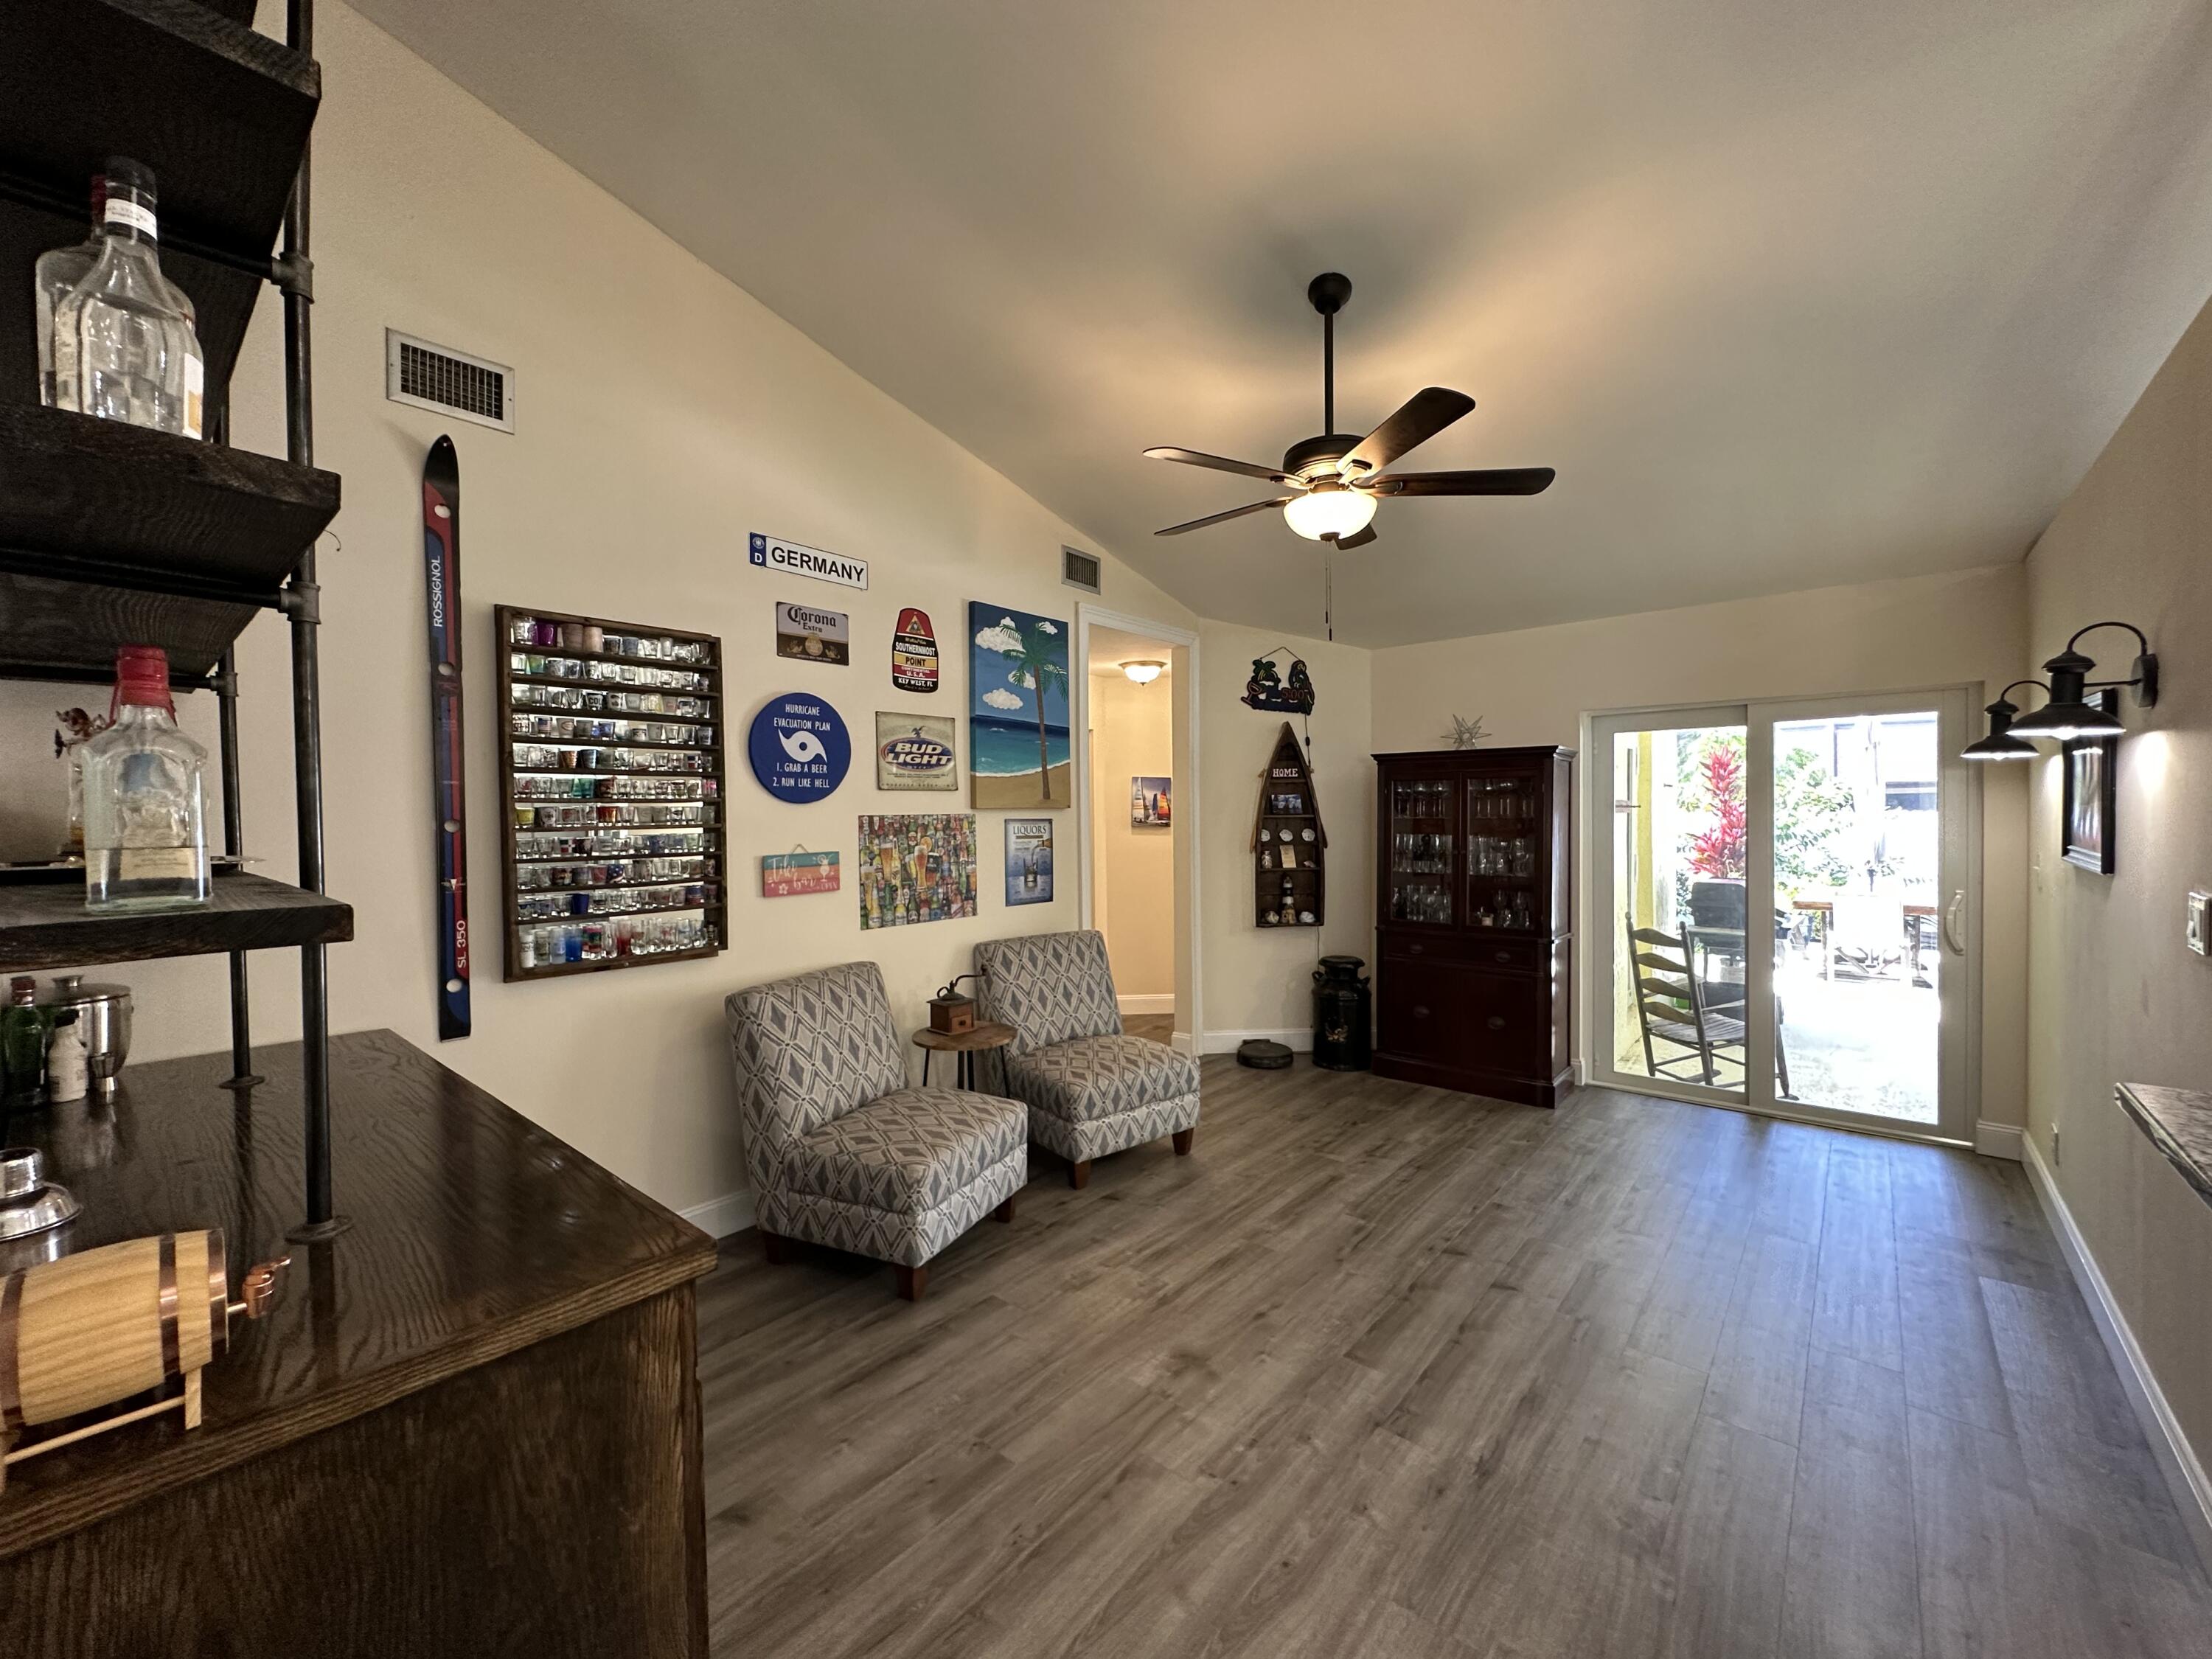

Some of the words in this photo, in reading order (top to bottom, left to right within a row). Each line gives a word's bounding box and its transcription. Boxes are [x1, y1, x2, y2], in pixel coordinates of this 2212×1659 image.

[754, 553, 763, 563] D
[771, 546, 864, 582] GERMANY
[431, 555, 442, 627] ROSSIGNOL
[787, 606, 836, 627] Corona
[803, 622, 823, 633] Extra
[895, 641, 936, 656] SOUTHERNMOST
[905, 657, 926, 667] POINT
[785, 703, 820, 716] HURRICANE
[773, 717, 812, 729] EVACUATION
[815, 721, 830, 731] PLAN
[894, 742, 942, 754] BUD
[885, 753, 952, 765] LIGHT
[776, 762, 782, 771] 1.
[784, 762, 801, 772] GRAB
[804, 764, 808, 772] A
[811, 764, 827, 773] BEER
[1273, 768, 1298, 777] HOME
[773, 777, 779, 787] 2.
[782, 777, 795, 787] RUN
[798, 778, 811, 787] LIKE
[814, 779, 830, 788] HELL
[1012, 825, 1047, 835] LIQUORS
[768, 855, 797, 882] Tiki
[793, 872, 816, 890] bar
[456, 920, 466, 947] 350
[457, 952, 466, 968] SL
